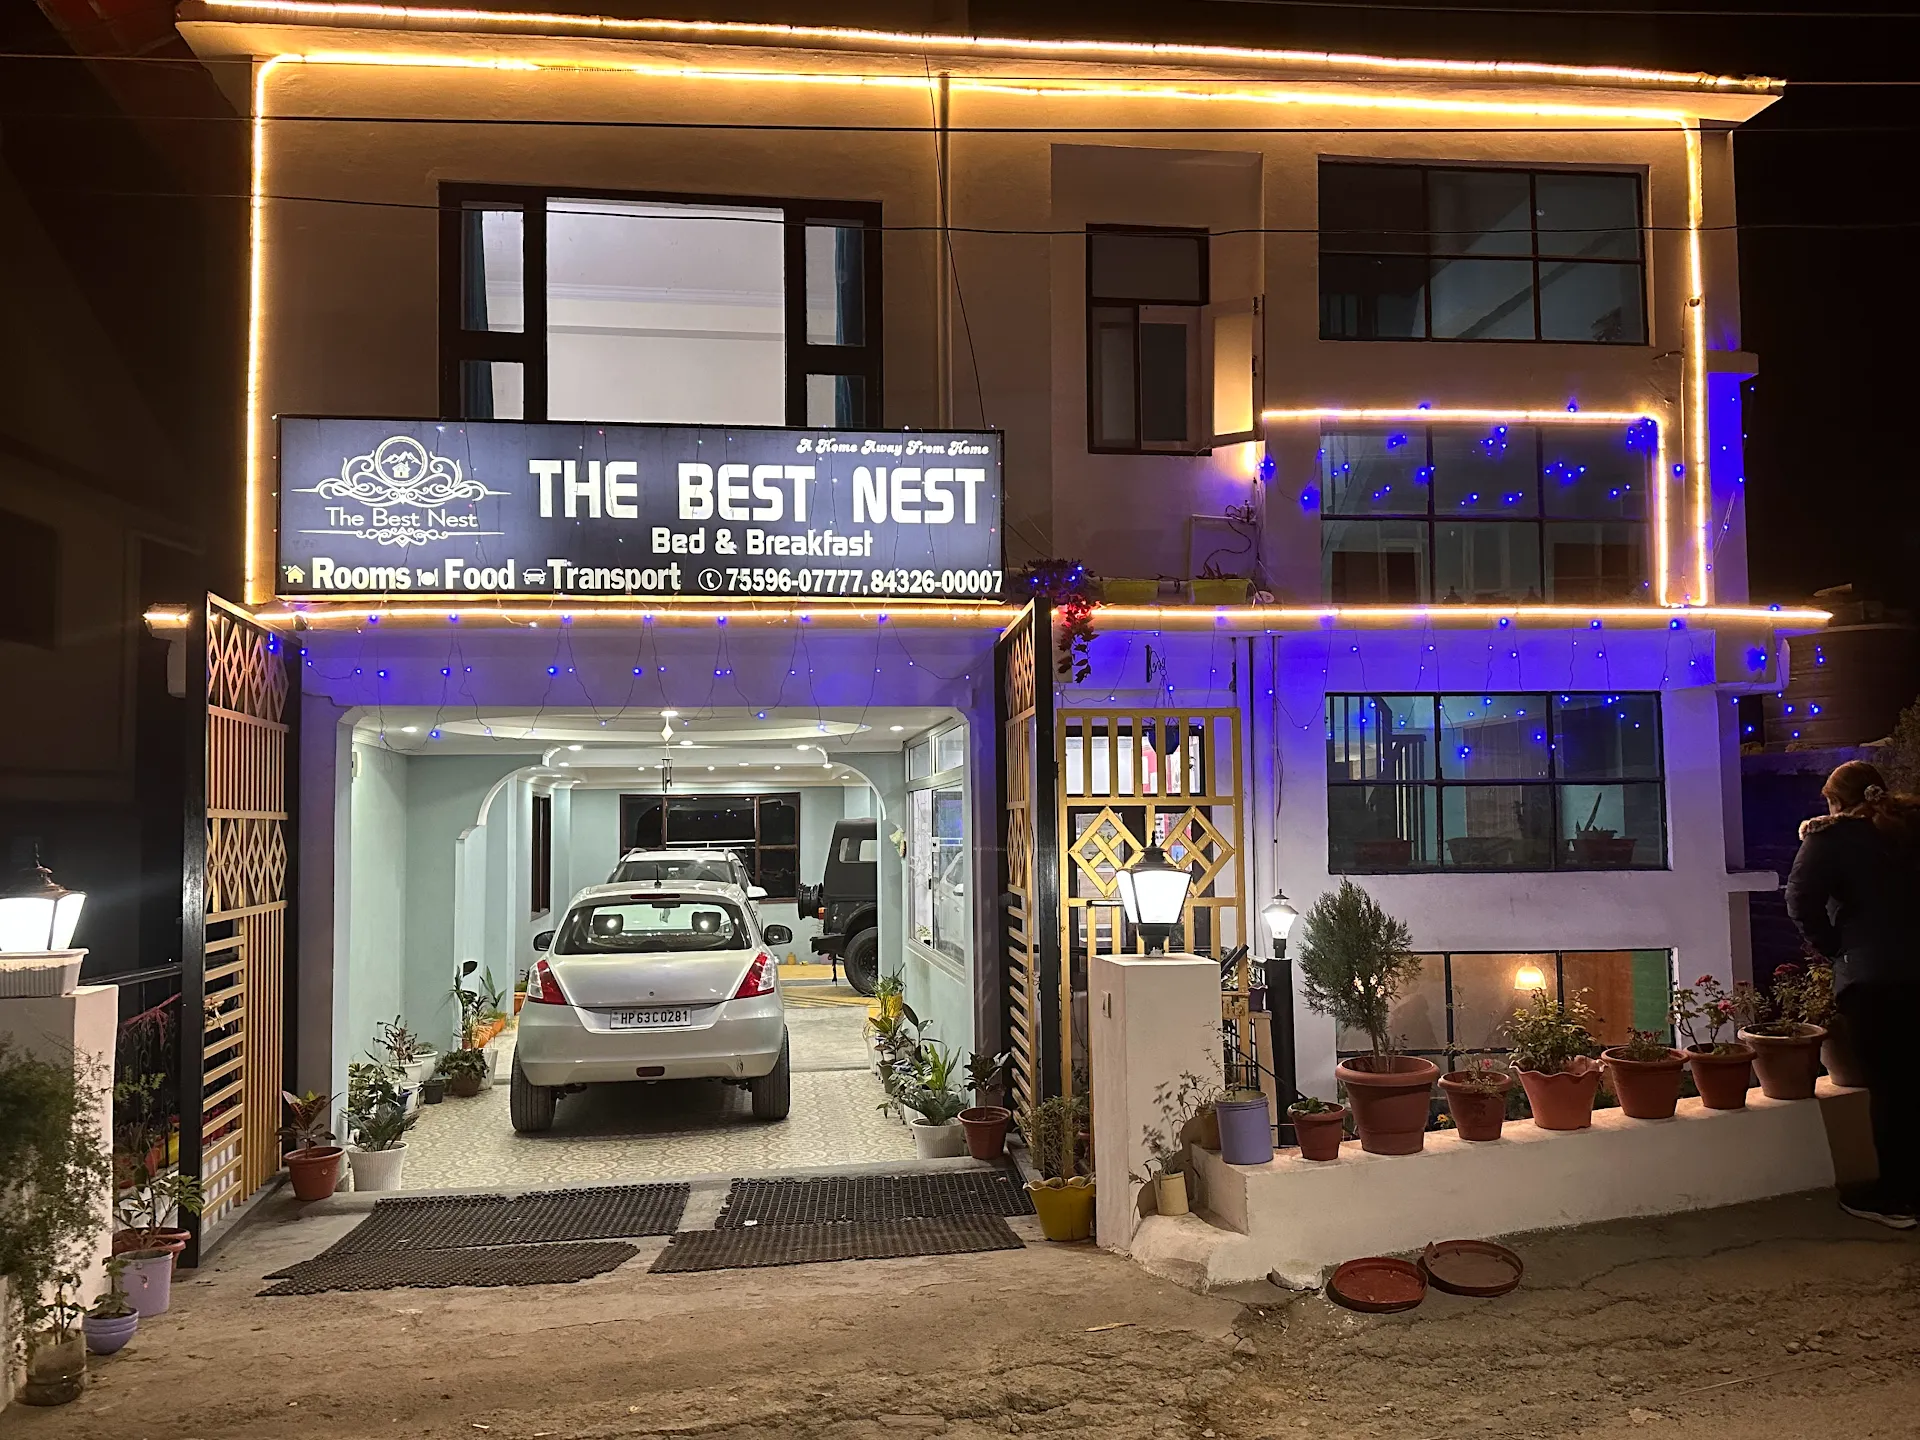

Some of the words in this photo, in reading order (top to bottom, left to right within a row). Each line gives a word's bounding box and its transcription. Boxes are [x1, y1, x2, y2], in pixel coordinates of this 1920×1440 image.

[529, 460, 639, 519] THE
[678, 463, 816, 522] BEST
[852, 467, 986, 523] NEST
[324, 507, 364, 526] The
[372, 508, 420, 528] Best
[427, 510, 478, 528] Nest
[652, 527, 705, 554] Bed
[715, 530, 738, 554] &
[747, 529, 873, 557] Breakfast
[312, 557, 411, 590] Rooms
[445, 559, 515, 590] Food
[547, 559, 681, 594] Transport
